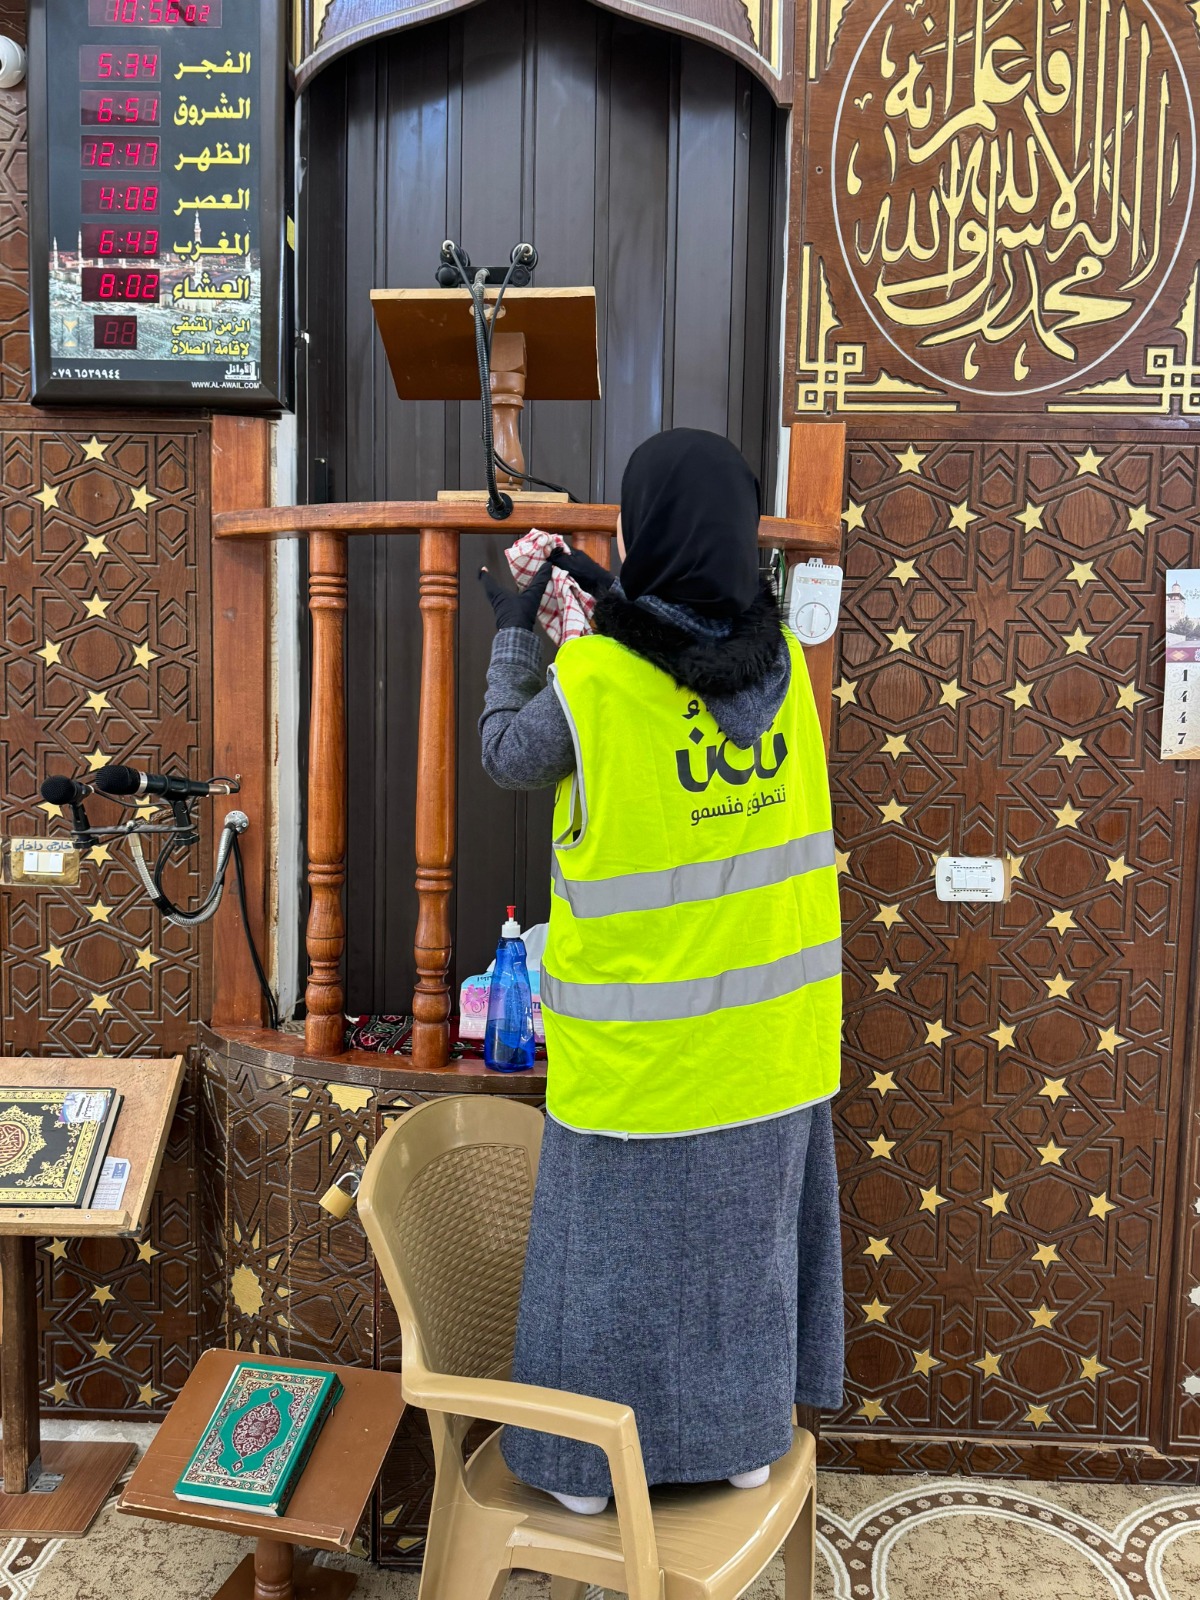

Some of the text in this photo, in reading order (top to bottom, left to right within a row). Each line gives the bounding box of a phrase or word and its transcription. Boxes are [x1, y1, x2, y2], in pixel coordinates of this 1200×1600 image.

[112, 0, 210, 23] 10:56 02
[98, 53, 157, 78] 5:34
[174, 50, 251, 80] الفجر
[97, 98, 157, 123] 6:51
[174, 92, 251, 126] الشروق
[89, 142, 158, 167] 12:47
[174, 142, 250, 171] الظهر
[99, 187, 158, 211] 4:08
[173, 188, 250, 216] العصر
[98, 230, 158, 255] 6:43
[173, 231, 250, 262] المغرب
[99, 273, 159, 299] 8:02
[172, 273, 250, 301] العشاء
[171, 316, 251, 337] الزمن المتبقي
[171, 339, 250, 360] لإقامة الصلاة
[191, 381, 259, 389] WWW.AL-AWAIL.COM
